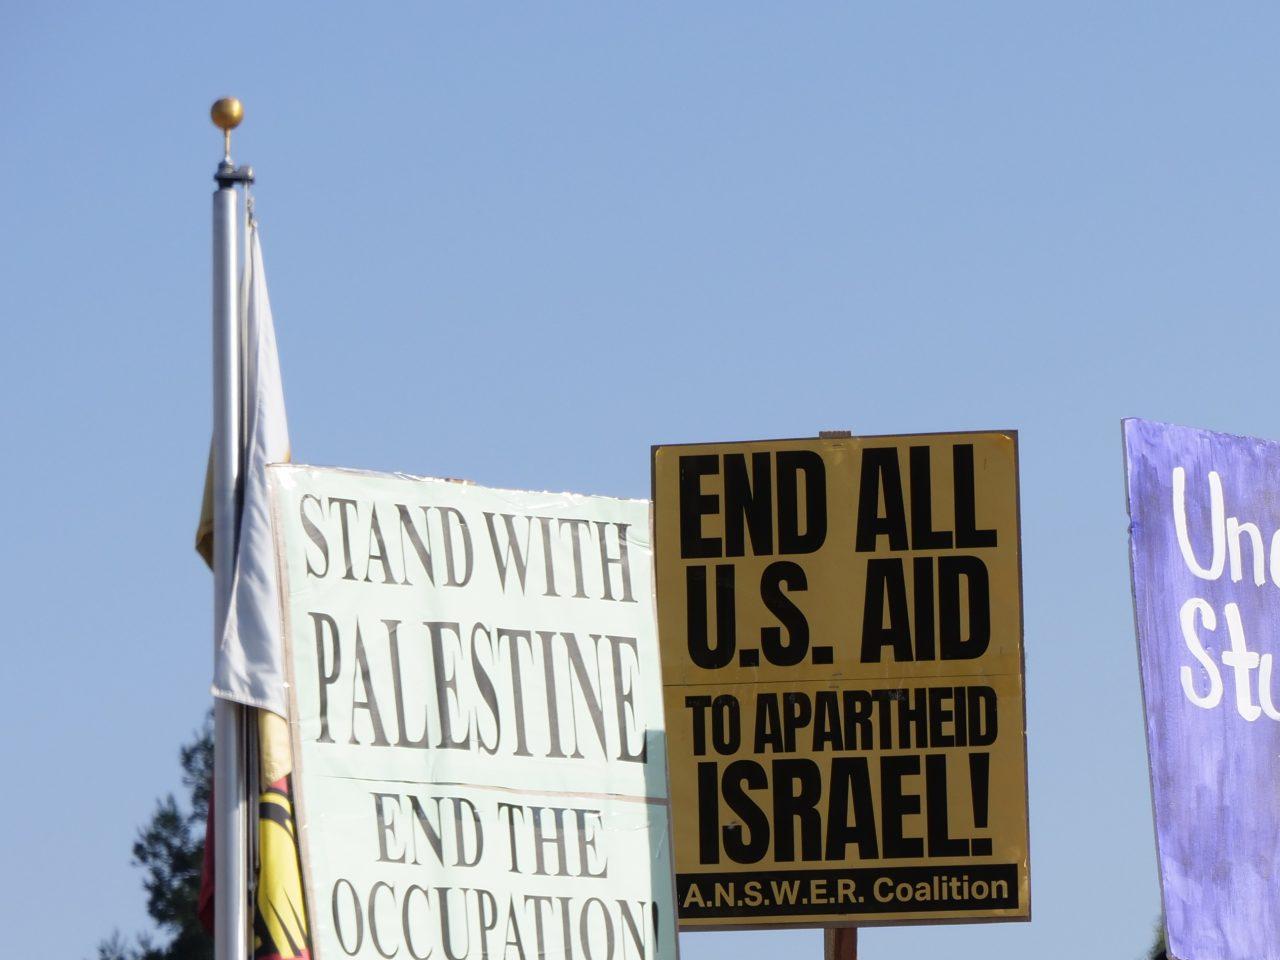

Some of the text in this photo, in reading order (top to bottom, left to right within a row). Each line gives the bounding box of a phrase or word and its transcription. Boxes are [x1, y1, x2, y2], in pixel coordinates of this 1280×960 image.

[300, 494, 638, 603] STAND WITH
[679, 444, 997, 559] END ALL
[686, 555, 991, 669] U.S. AID
[308, 612, 648, 764] PALESTINE
[685, 685, 998, 756] TO APARTHEID
[369, 792, 608, 879] END THE
[697, 752, 993, 865] ISRAEL!
[683, 875, 1008, 908] A.N.S.W.E.R. Coalition
